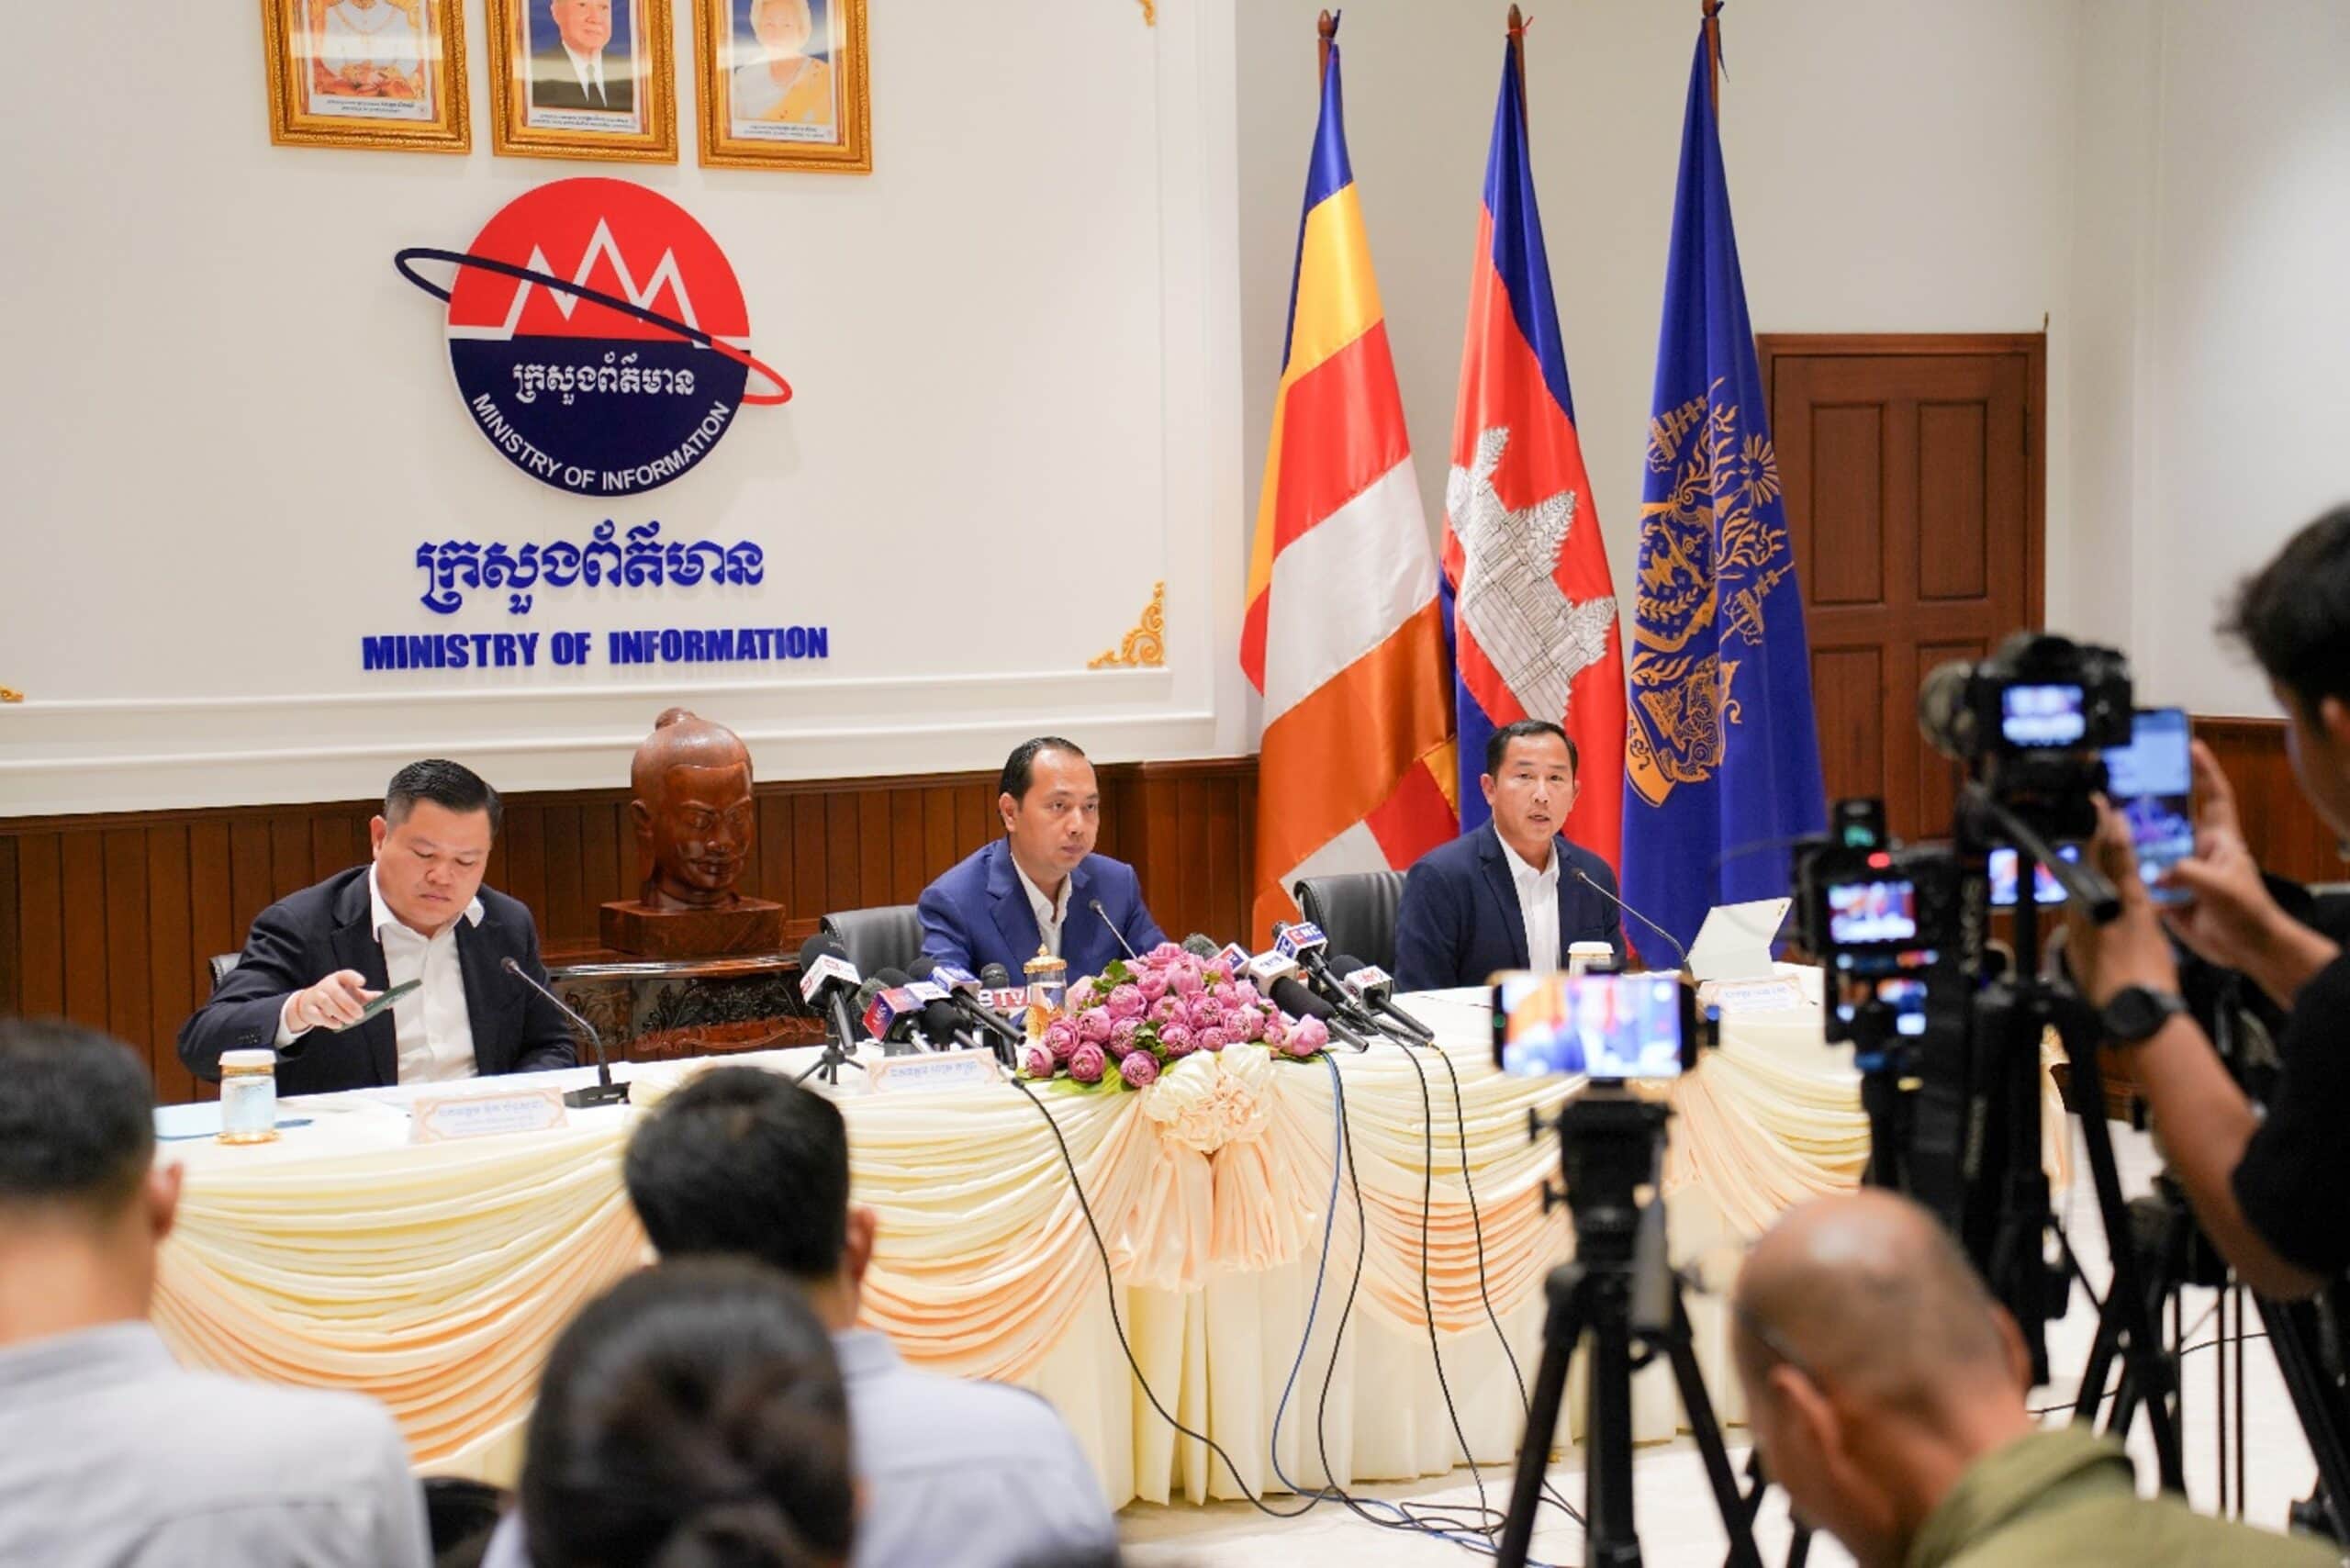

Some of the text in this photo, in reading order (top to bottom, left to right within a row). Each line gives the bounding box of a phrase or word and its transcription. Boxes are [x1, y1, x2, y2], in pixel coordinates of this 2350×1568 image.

[512, 351, 696, 406] ក្រសួងព័ត៌មាន
[473, 393, 732, 490] MINISTRY OF INFORMATION
[416, 520, 765, 615] ក្រសួងព័ត៌មាន
[361, 626, 829, 671] MINISTRY OF INFORMATION
